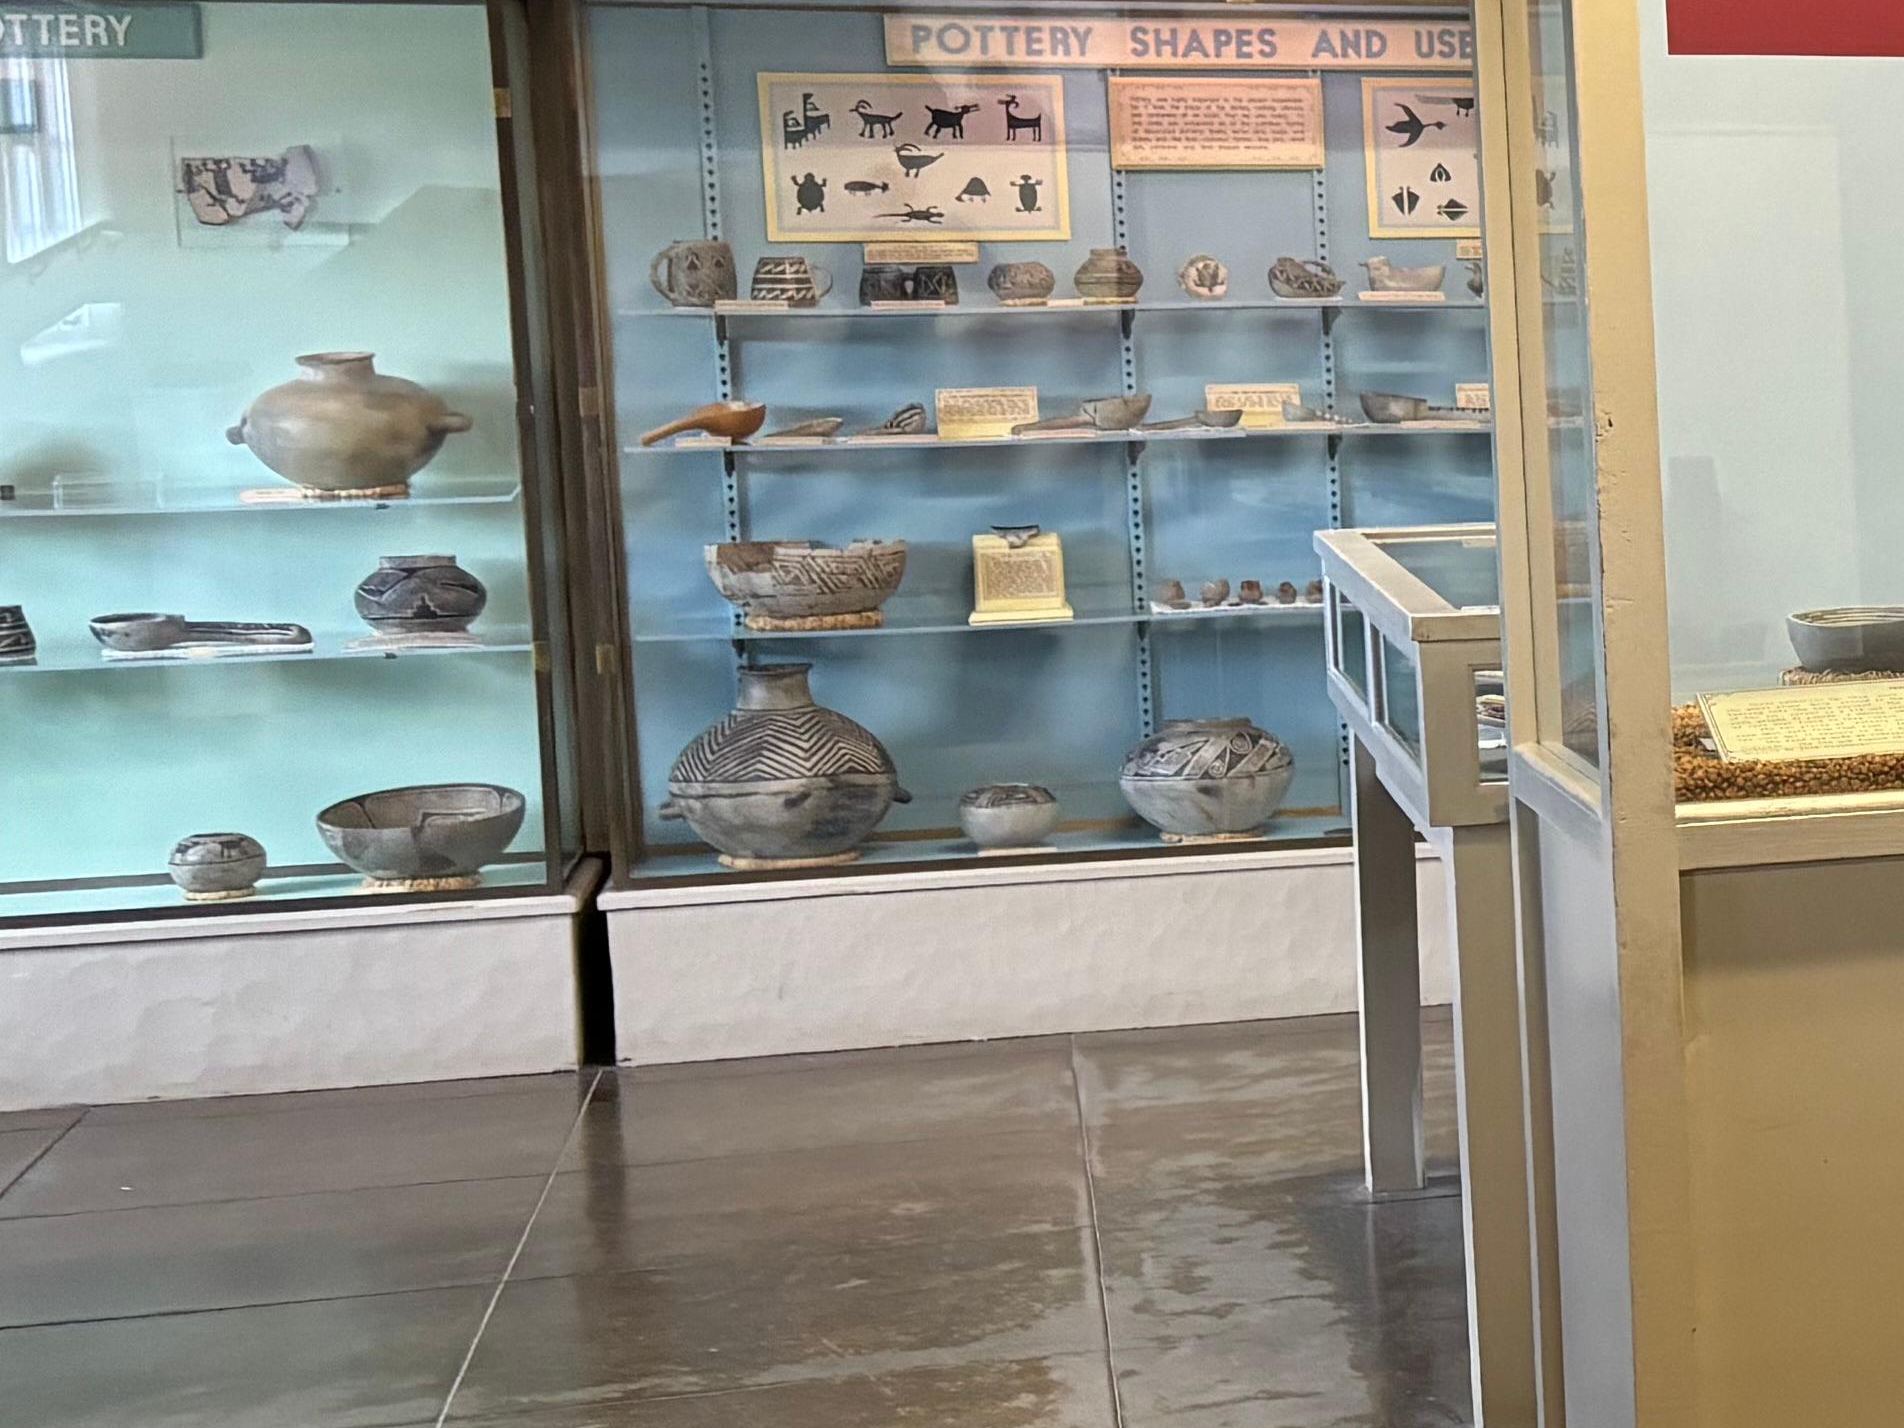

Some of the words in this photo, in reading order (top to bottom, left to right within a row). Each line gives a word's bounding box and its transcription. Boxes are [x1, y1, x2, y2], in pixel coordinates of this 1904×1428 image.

[0, 14, 132, 46] TTERY
[911, 22, 1093, 58] POTTERY
[1130, 26, 1277, 59] SHAPES
[1311, 29, 1387, 59] AND
